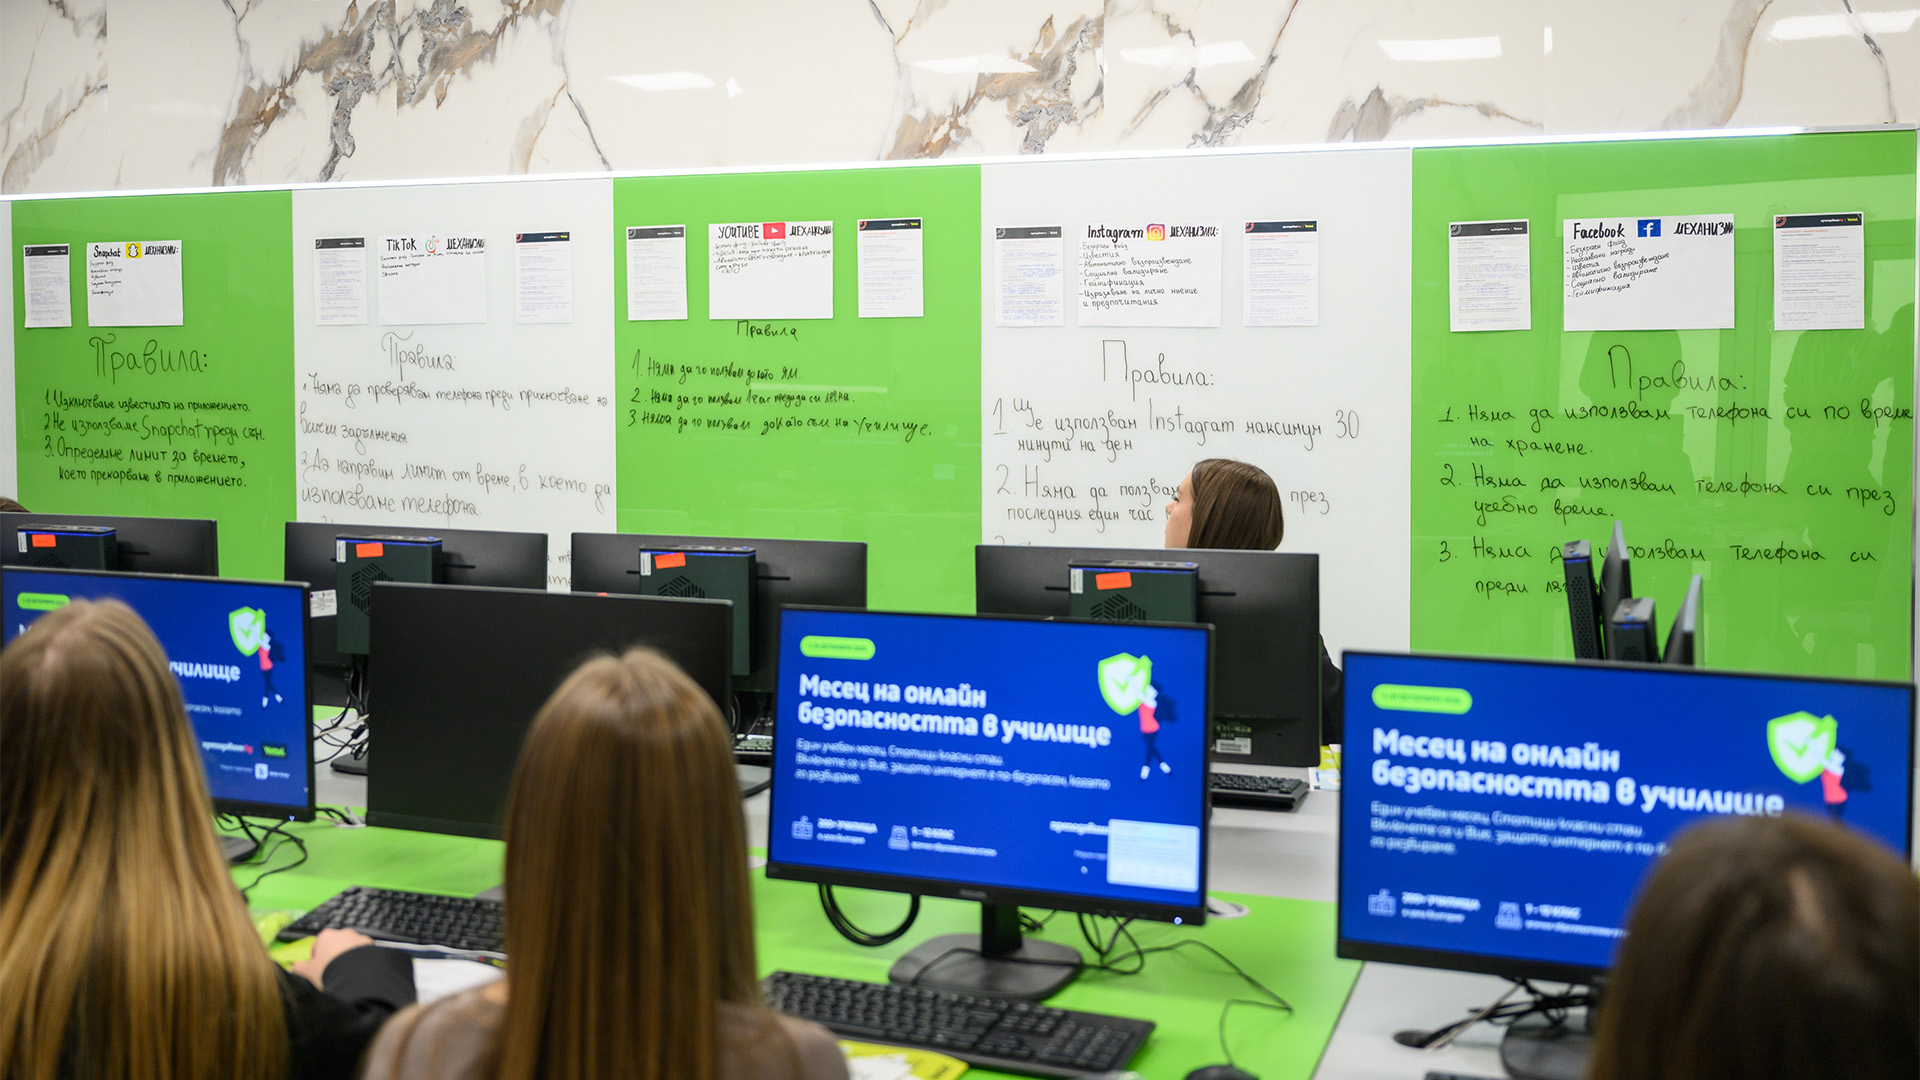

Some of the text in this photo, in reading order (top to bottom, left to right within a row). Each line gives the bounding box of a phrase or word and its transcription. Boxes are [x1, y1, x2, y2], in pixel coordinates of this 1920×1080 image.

[718, 225, 760, 239] YOUTUBE
[1088, 224, 1144, 244] Instagram
[1573, 222, 1626, 240] Facebook
[93, 244, 121, 259] Snapchat
[1132, 288, 1141, 296] на
[736, 320, 798, 341] Правила
[89, 333, 208, 385] Правила:
[632, 349, 643, 378] 1.
[648, 356, 675, 376] Няма
[679, 364, 692, 384] да
[696, 365, 707, 376] го
[710, 362, 744, 378] ползвам
[1103, 340, 1214, 402] Правила:
[1608, 345, 1747, 402] Правила:
[54, 389, 115, 412] Изключваме
[174, 401, 186, 410] на
[308, 372, 342, 395] Няма
[345, 383, 361, 409] да
[436, 388, 482, 406] телефона
[486, 389, 513, 411] преди
[597, 395, 608, 407] на
[631, 387, 648, 403] 2.
[650, 388, 673, 404] Няма
[677, 394, 690, 410] да
[693, 396, 704, 406] го
[708, 392, 742, 407] ползвам
[809, 394, 821, 403] си
[53, 412, 66, 431] Не
[72, 417, 139, 436] използваме
[140, 415, 204, 446] Snapchat
[204, 425, 239, 446] преди
[678, 416, 688, 434] да
[692, 418, 702, 428] го
[707, 417, 750, 431] ползвам
[806, 417, 830, 428] съм
[835, 418, 850, 428] на
[1013, 397, 1360, 452] Ще използвам Instagram максимум 30
[1438, 406, 1460, 422] 1.
[1468, 404, 1516, 422] Няма
[1530, 408, 1554, 434] да
[1564, 400, 1671, 421] използвам
[1686, 401, 1773, 428] телефона
[1786, 406, 1812, 420] си
[1824, 405, 1850, 420] по
[44, 435, 246, 469] 3. лимит за времето,
[1018, 438, 1133, 462] минути на ден
[1470, 436, 1494, 448] на
[1506, 438, 1593, 458] хранене.
[59, 466, 246, 487] което прекарваме в приложението.
[337, 459, 394, 480] направим
[401, 463, 447, 480] лимит
[452, 470, 471, 482] от
[519, 464, 529, 490] в
[538, 475, 587, 494] което
[594, 484, 611, 516] да
[996, 464, 1017, 495] 2.
[1025, 464, 1076, 499] Няма
[1090, 485, 1108, 512] да
[1440, 462, 1896, 516] 2. Няма да използвам телефона си през
[301, 483, 396, 513] използваме
[1290, 491, 1330, 515] през
[1474, 495, 1614, 526] учебно време.
[1008, 508, 1083, 534] последния
[1089, 508, 1120, 534] един
[1129, 508, 1154, 521] час
[1439, 540, 1458, 562] 3.
[1472, 536, 1532, 558] Няма
[1850, 551, 1878, 562] си
[1475, 580, 1528, 600] преди
[800, 673, 987, 709] Месец на онлайн
[798, 701, 1112, 748] безопасността в училище
[1372, 728, 1620, 774] Месец на онлайн
[1372, 760, 1785, 819] безопасността в училище
